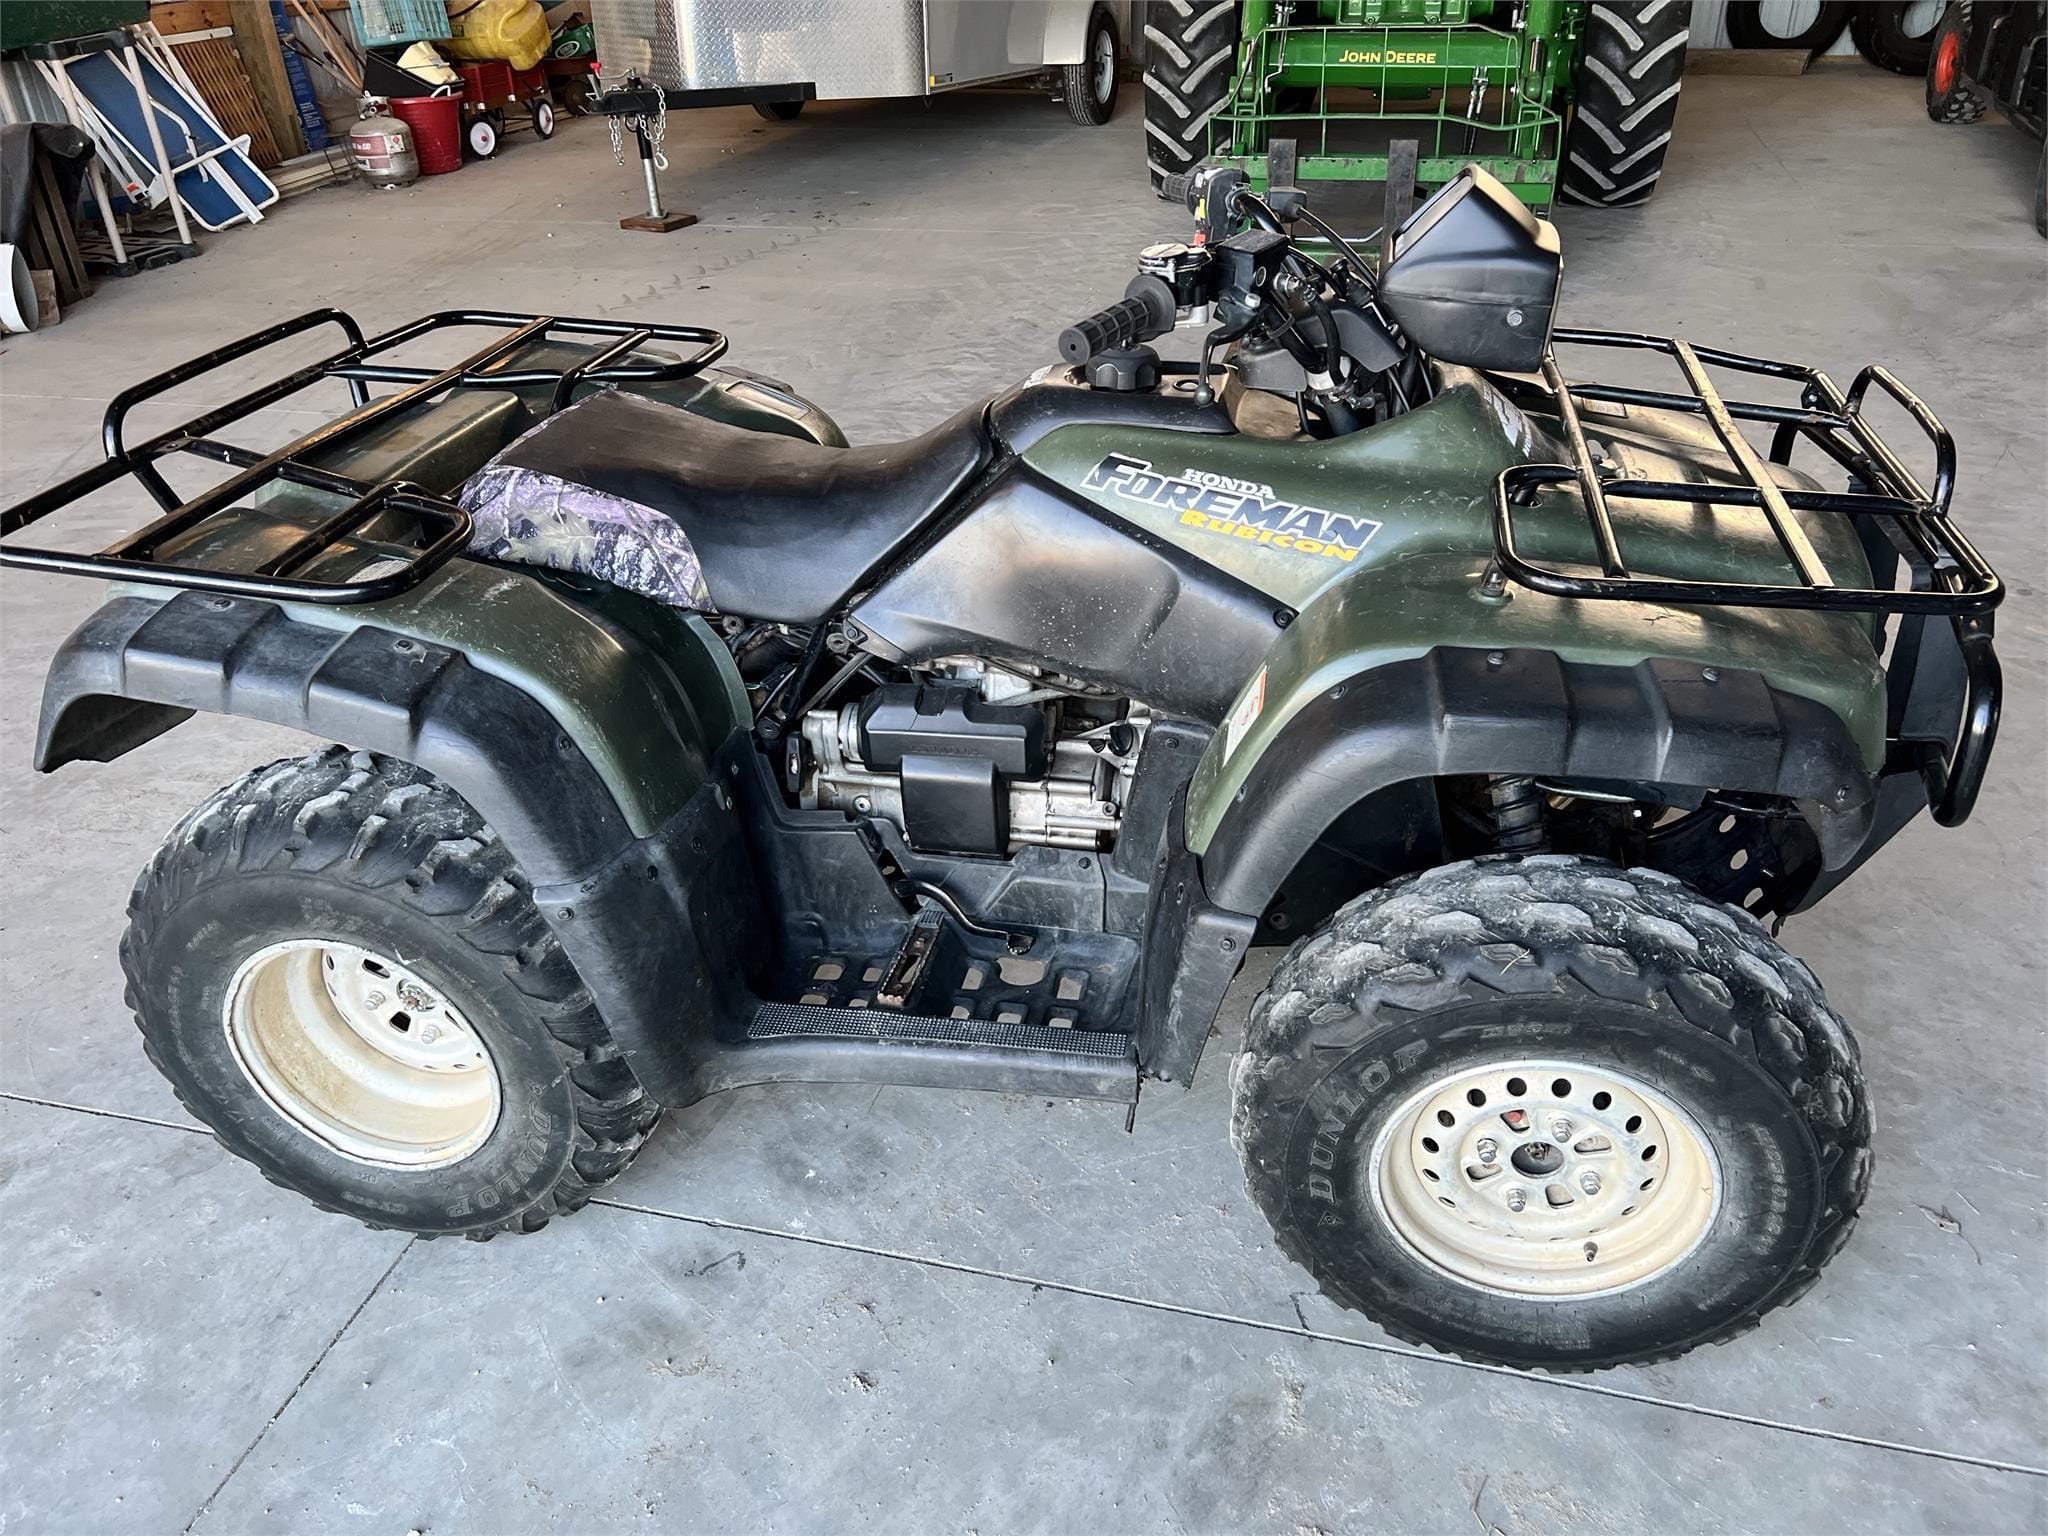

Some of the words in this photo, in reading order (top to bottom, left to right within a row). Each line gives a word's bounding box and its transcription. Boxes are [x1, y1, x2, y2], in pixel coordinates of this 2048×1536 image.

[1339, 49, 1381, 63] JOHN
[1385, 50, 1437, 64] DEERE
[1080, 452, 1383, 550] FOREMAN
[1182, 468, 1276, 500] HONDA
[1179, 508, 1361, 562] RUBICON
[446, 1099, 553, 1218] DUNLOP
[1309, 1038, 1430, 1204] DUNLOP
